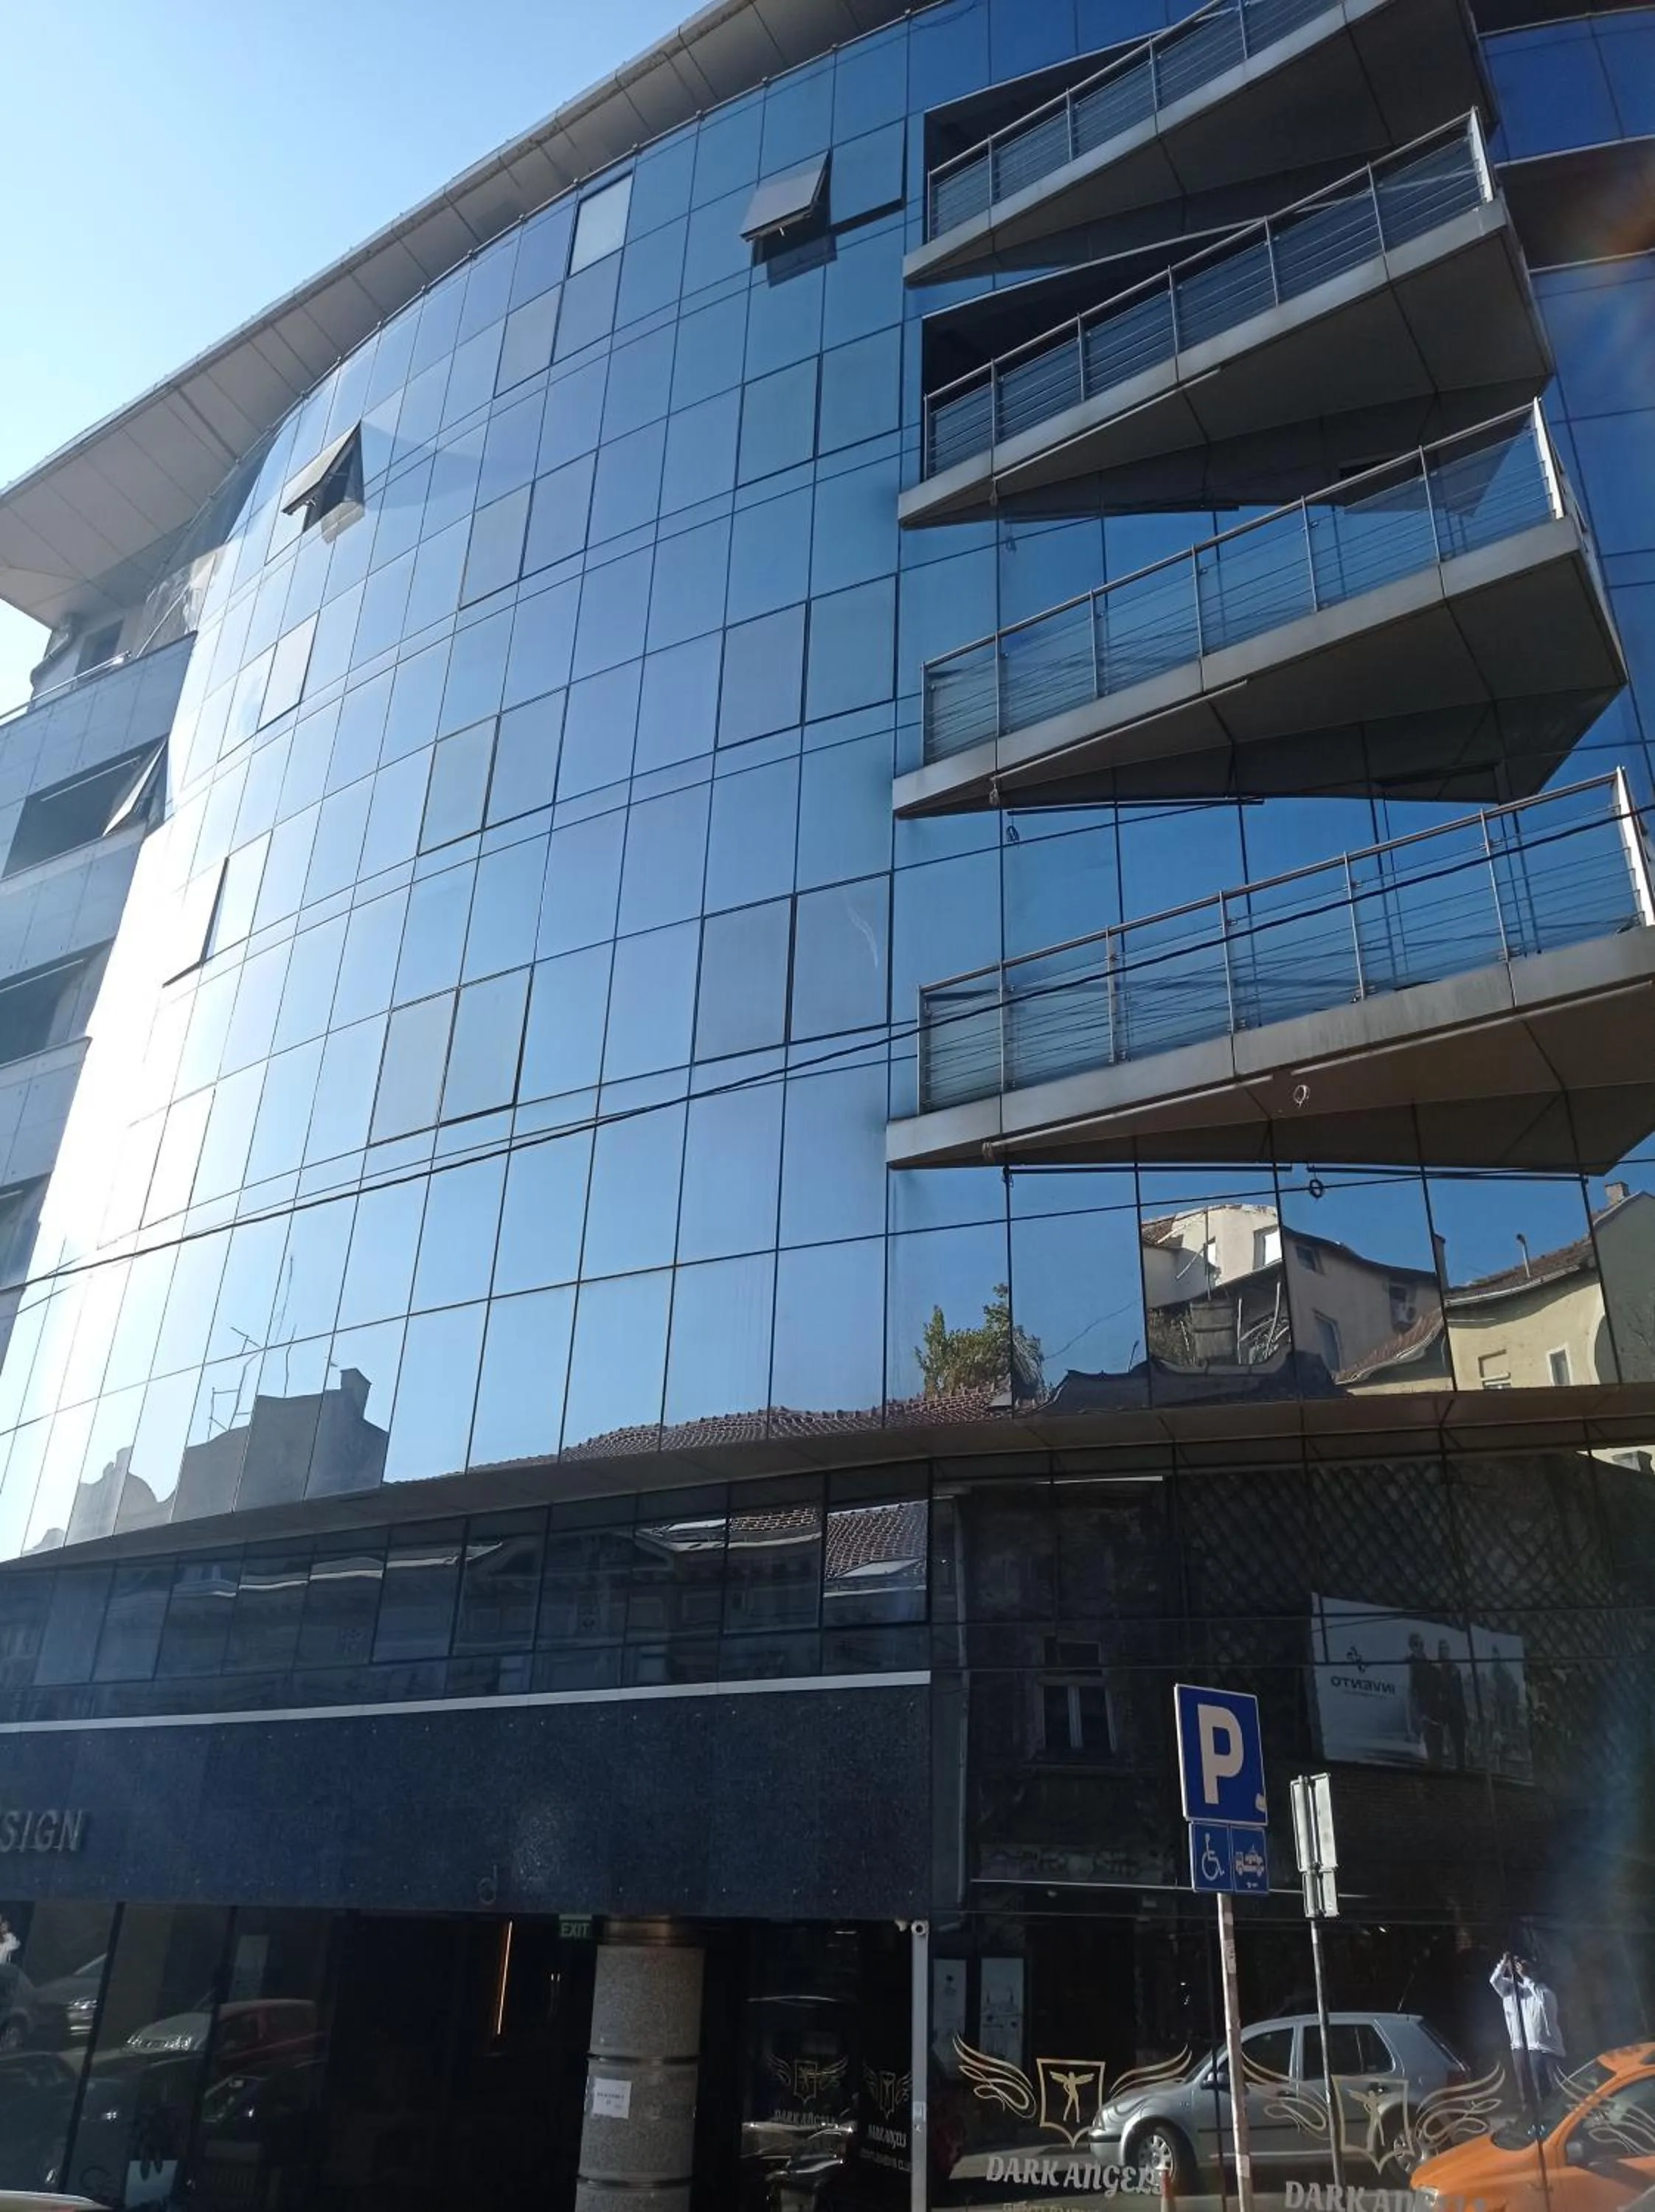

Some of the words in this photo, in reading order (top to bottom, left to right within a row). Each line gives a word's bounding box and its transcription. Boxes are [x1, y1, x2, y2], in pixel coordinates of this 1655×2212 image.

[1197, 1703, 1245, 1805] P
[0, 1807, 83, 1853] SIGN
[561, 1922, 590, 1938] EXIT
[986, 2157, 1060, 2186] DARK
[1284, 2180, 1365, 2212] DARK
